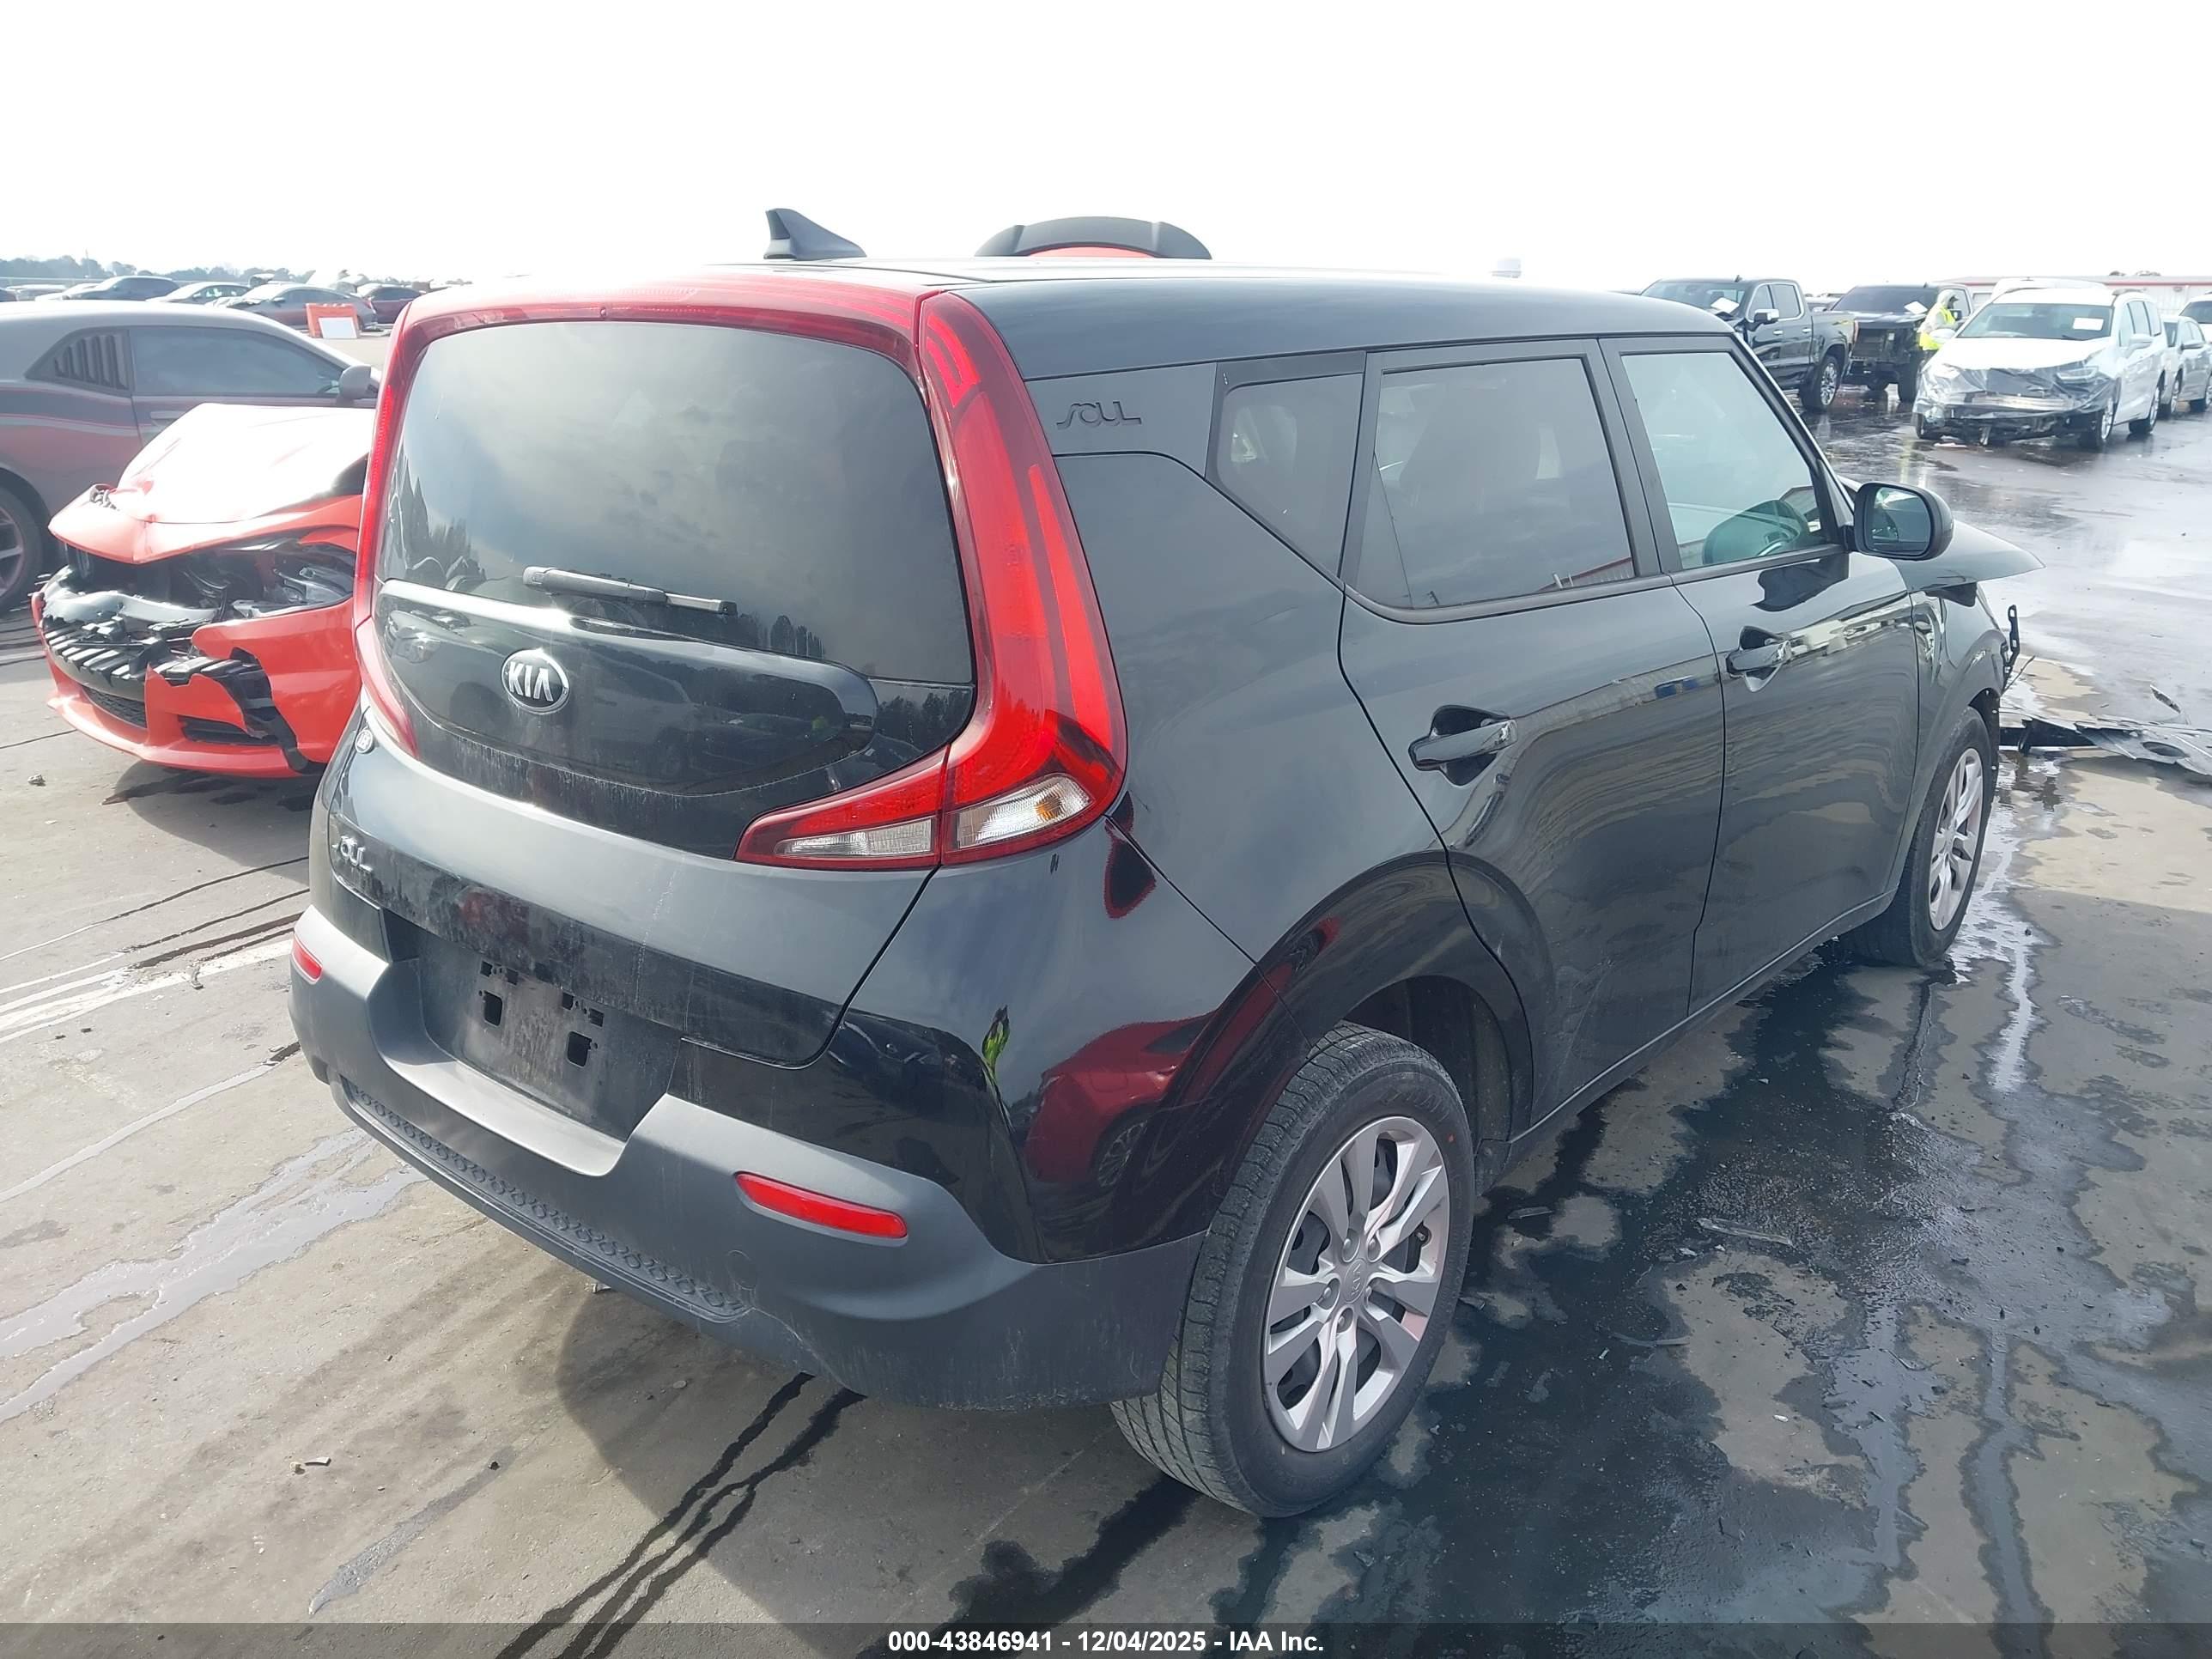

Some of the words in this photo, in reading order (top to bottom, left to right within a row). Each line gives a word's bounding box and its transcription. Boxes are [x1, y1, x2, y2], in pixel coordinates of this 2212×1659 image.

[1056, 400, 1143, 430] SOUL
[507, 660, 555, 702] KIA
[1351, 1262, 1361, 1297] KIA
